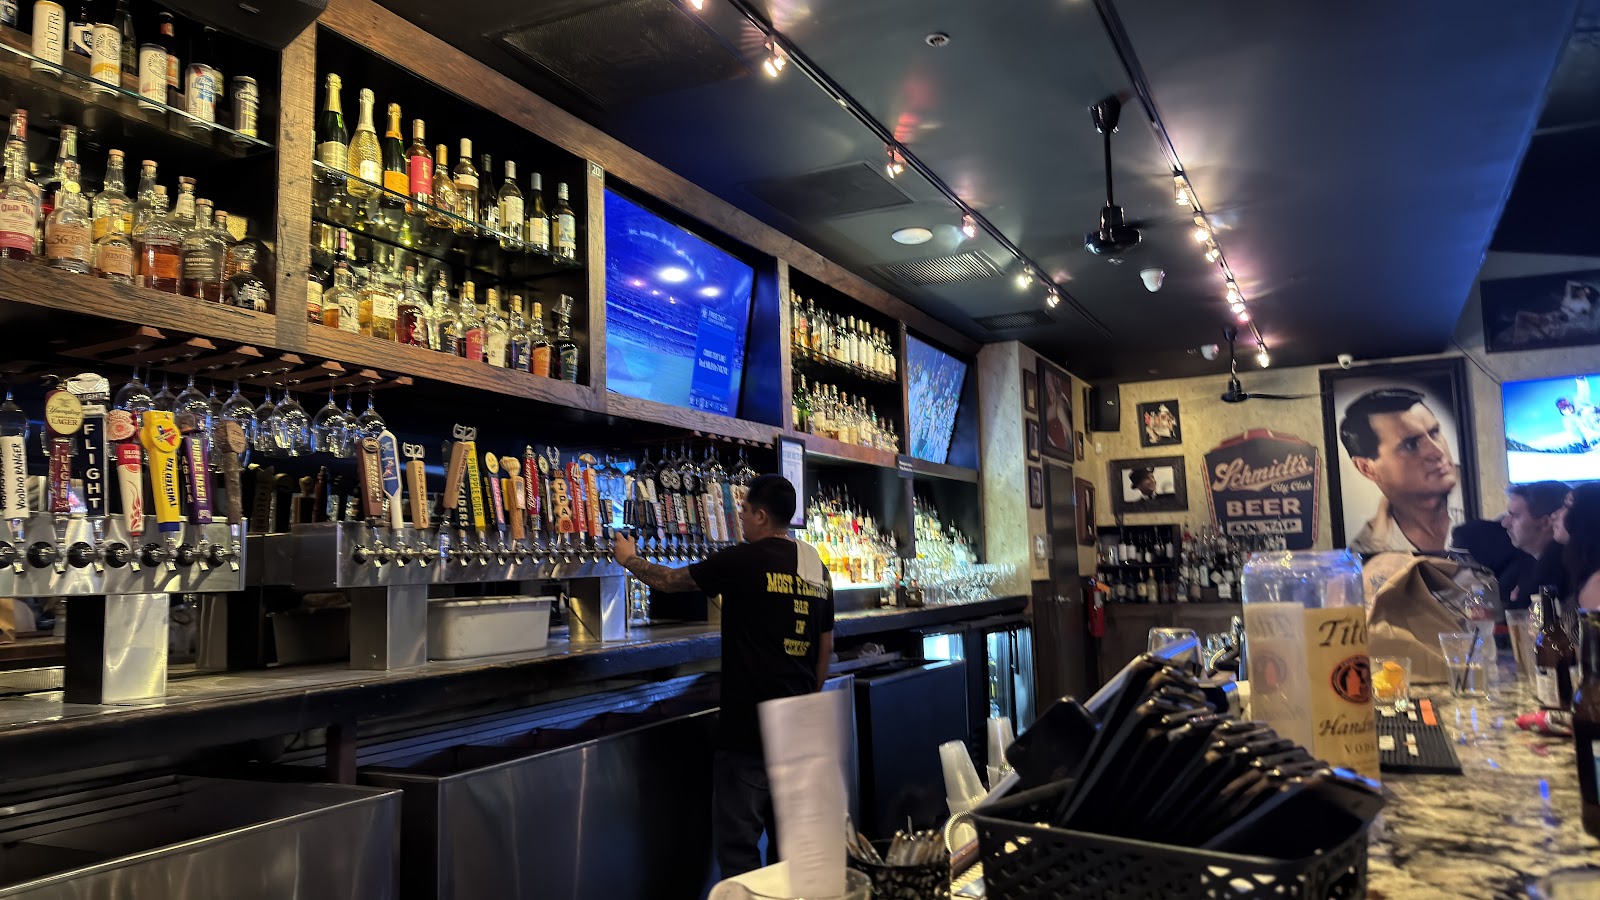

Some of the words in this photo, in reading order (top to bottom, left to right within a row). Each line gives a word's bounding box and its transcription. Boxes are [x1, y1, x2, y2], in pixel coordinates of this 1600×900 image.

[51, 417, 78, 426] LAGER
[11, 443, 25, 475] RANGER
[83, 423, 102, 509] FLIGHT
[166, 457, 175, 473] TEA
[192, 437, 205, 472] PURPLE
[60, 455, 71, 499] LAGER
[182, 455, 194, 504] ABITA
[194, 473, 207, 498] HAZE
[468, 457, 481, 497] PINEAPPLE
[1212, 453, 1314, 492] Schmidt's
[16, 476, 26, 511] VOODOO
[165, 473, 178, 508] TWISTED
[557, 482, 568, 516] IPA
[1270, 481, 1289, 495] City
[1290, 480, 1312, 492] Club
[473, 497, 483, 517] CIDER
[1226, 497, 1302, 517] BEER
[766, 572, 794, 594] MOST
[793, 599, 810, 615] BAR
[795, 619, 807, 635] IN
[783, 637, 811, 657] TEXAS
